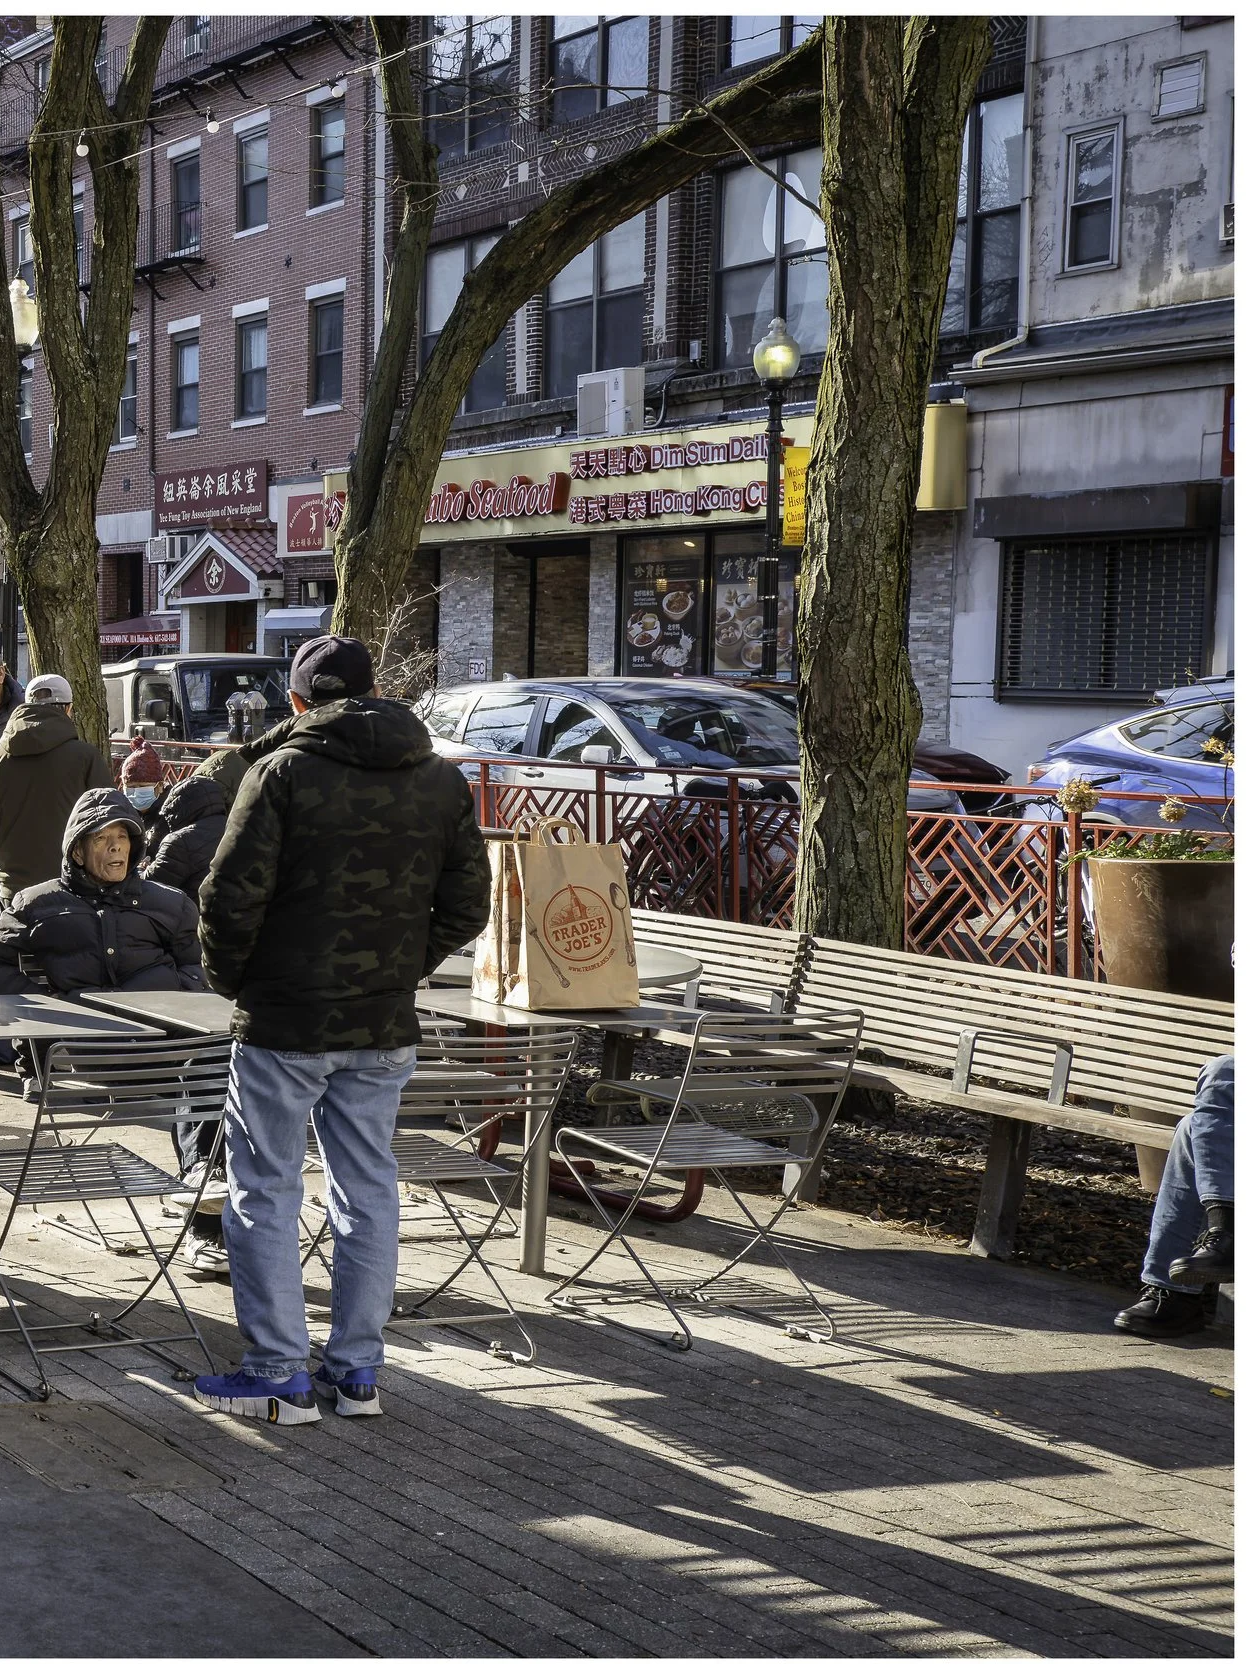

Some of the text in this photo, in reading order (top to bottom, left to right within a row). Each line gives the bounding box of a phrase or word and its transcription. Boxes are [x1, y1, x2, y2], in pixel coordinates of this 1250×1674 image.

[569, 445, 646, 479] 天天點心
[650, 445, 684, 469] Dim
[686, 440, 727, 465] Sum
[425, 472, 556, 523] mbo Seafood
[650, 490, 695, 516] Hong
[696, 486, 743, 512] Kong
[159, 502, 262, 523] Yee Fung Toy Association of New England
[786, 512, 804, 523] China
[207, 558, 222, 586] 余
[470, 662, 485, 675] FDC
[552, 917, 608, 942] TRADER
[564, 932, 602, 953] JOE'S
